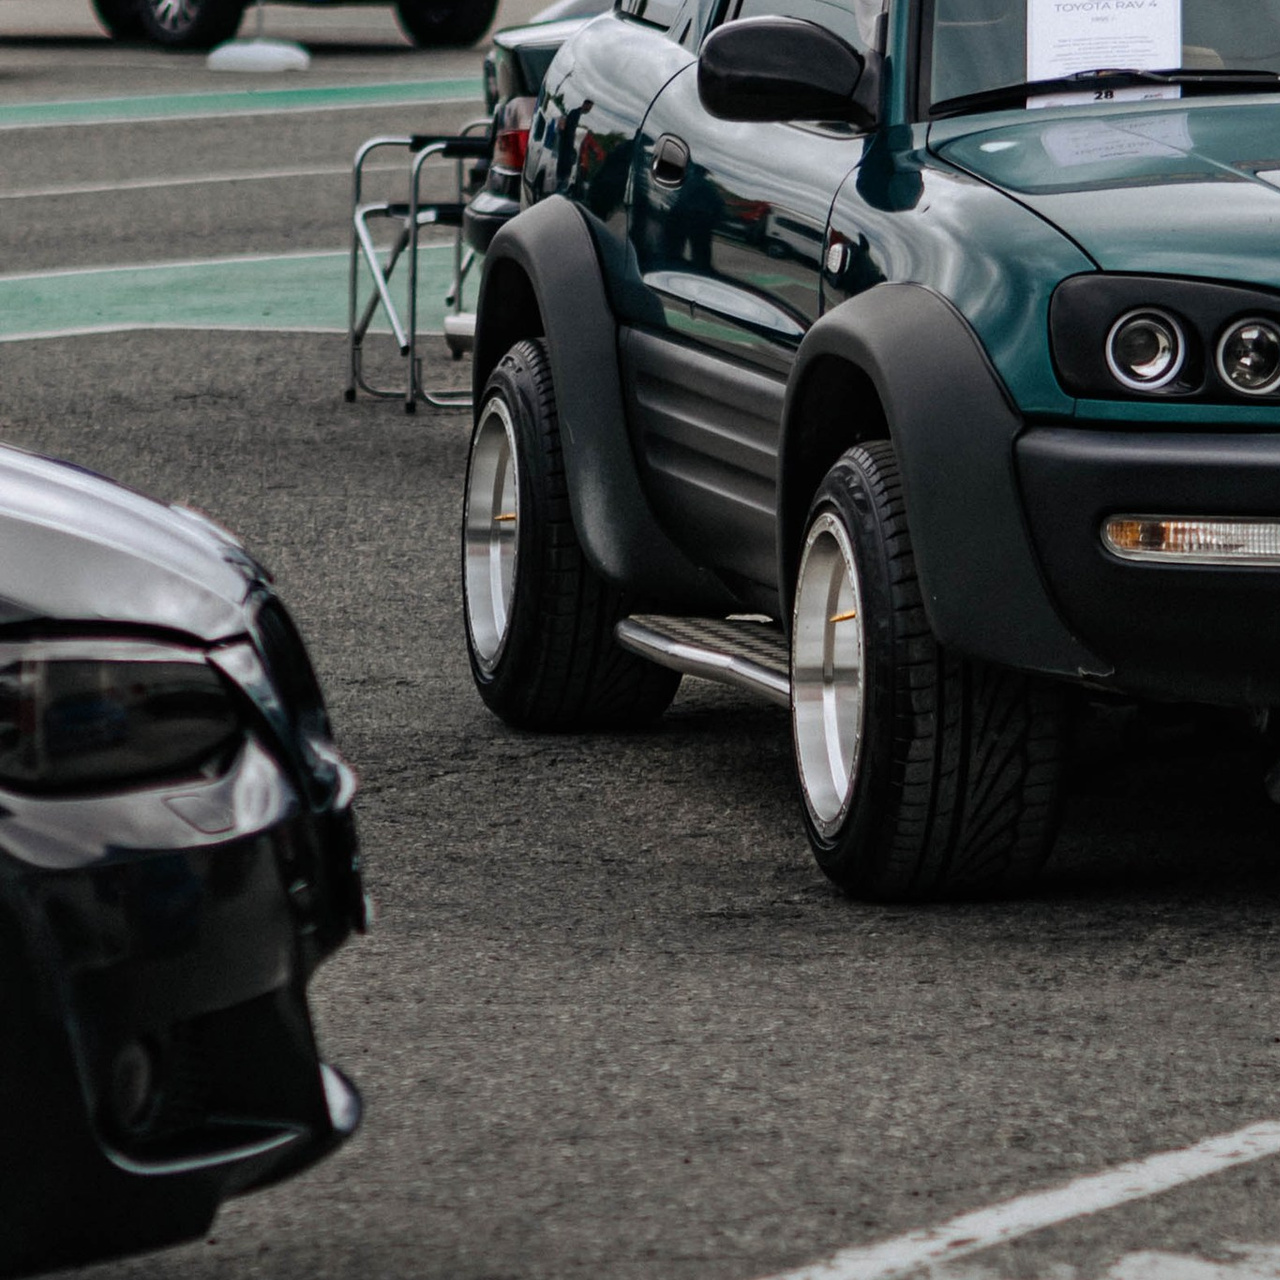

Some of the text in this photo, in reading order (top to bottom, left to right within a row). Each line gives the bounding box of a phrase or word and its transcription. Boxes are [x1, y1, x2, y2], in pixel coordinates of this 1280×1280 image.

[1054, 1, 1111, 13] TOYOTA
[1114, 0, 1145, 10] RAV
[1093, 89, 1114, 100] 28
